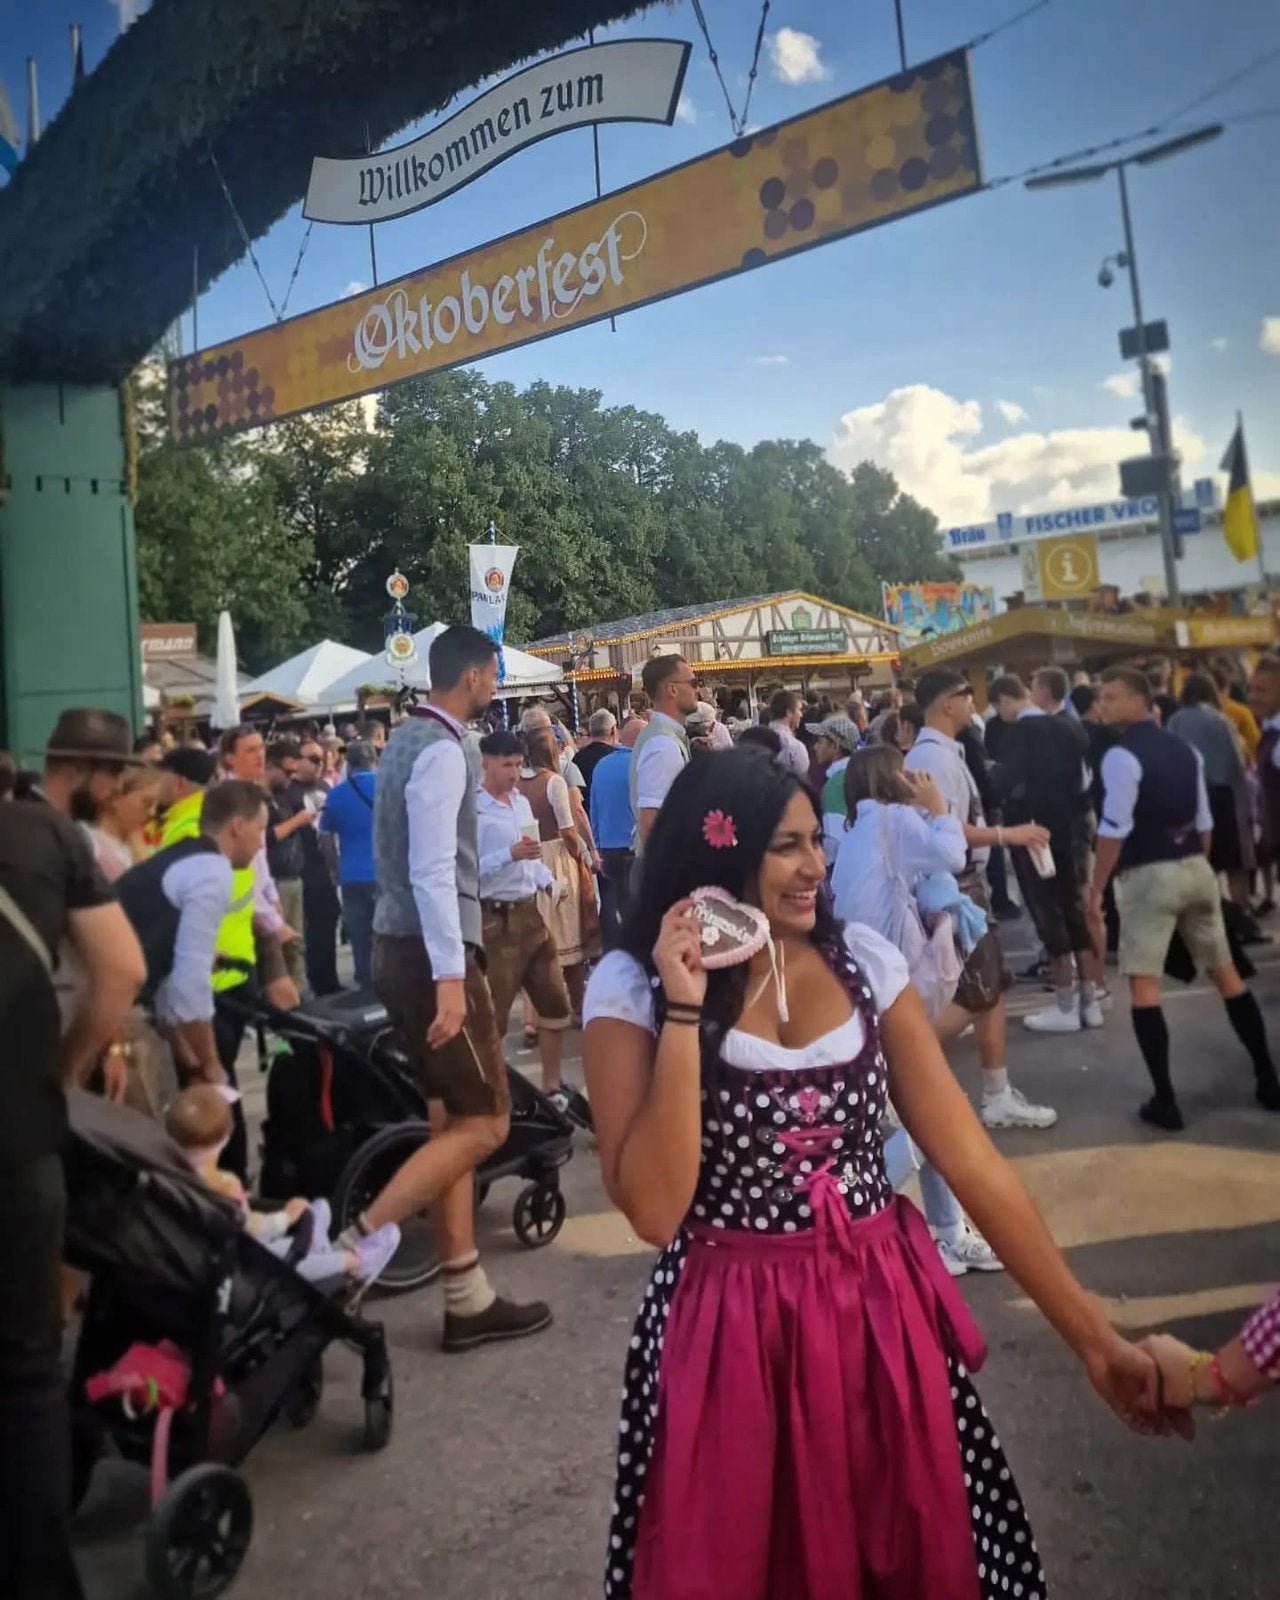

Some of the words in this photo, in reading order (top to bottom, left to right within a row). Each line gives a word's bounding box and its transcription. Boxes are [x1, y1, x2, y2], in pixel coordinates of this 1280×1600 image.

[357, 97, 530, 206] Willkommen
[539, 73, 605, 119] zum
[347, 211, 647, 373] Oktoberfest
[1025, 506, 1105, 535] FISCHER
[1111, 495, 1159, 519] VRO
